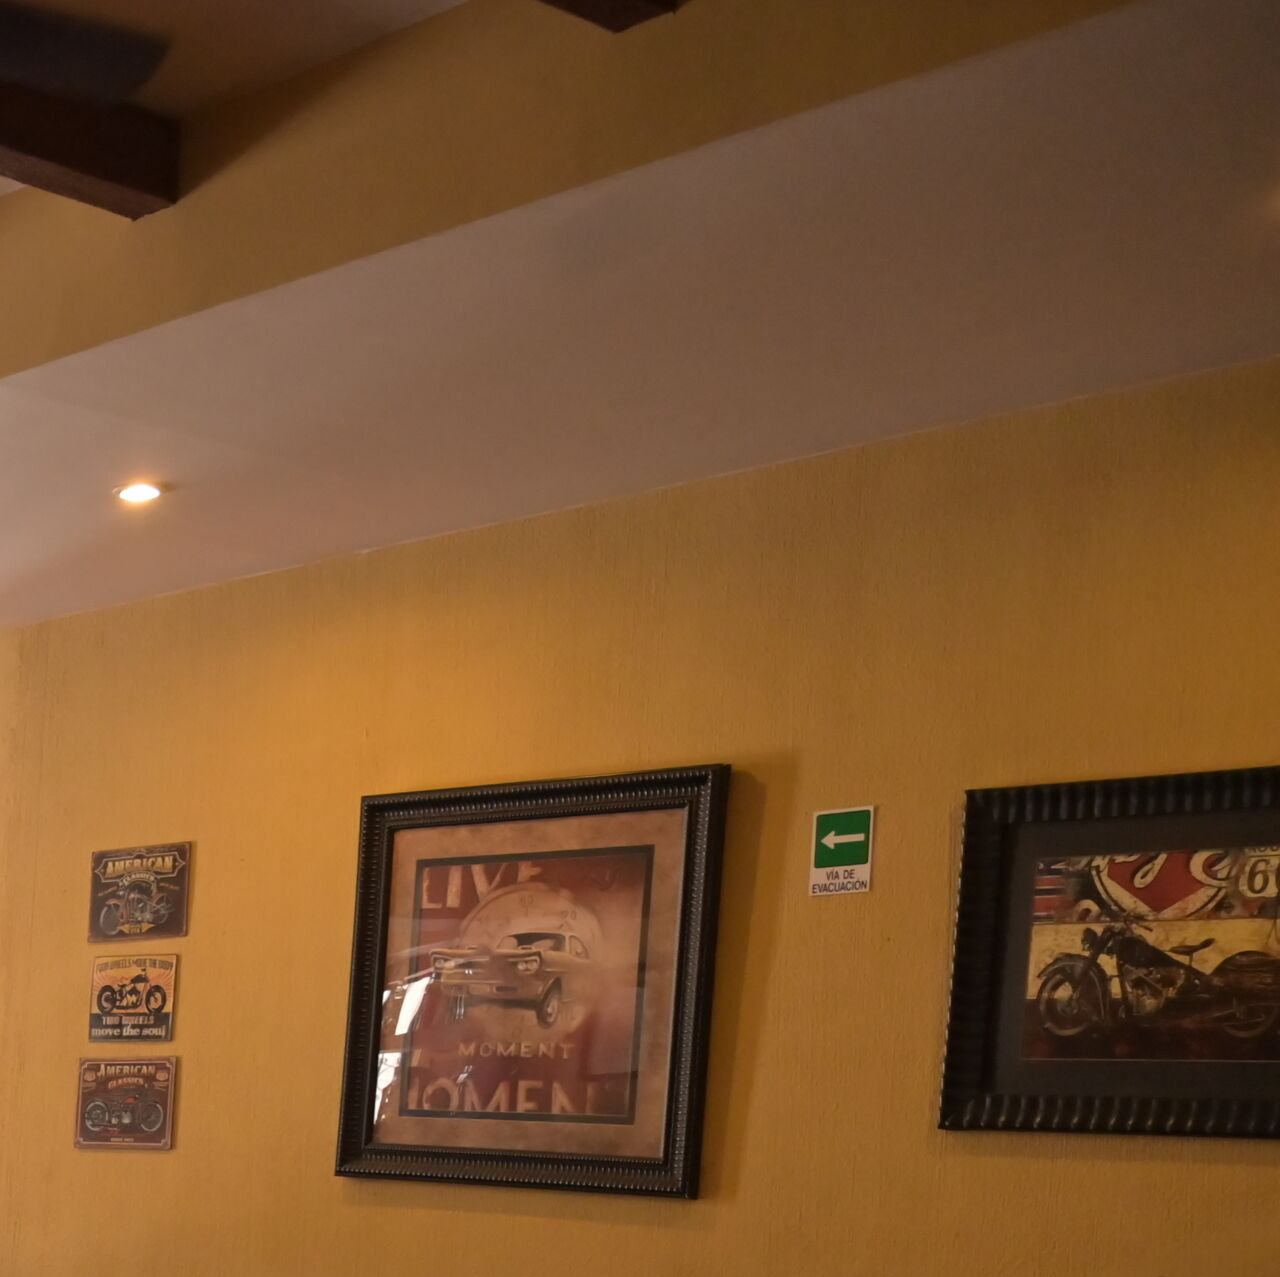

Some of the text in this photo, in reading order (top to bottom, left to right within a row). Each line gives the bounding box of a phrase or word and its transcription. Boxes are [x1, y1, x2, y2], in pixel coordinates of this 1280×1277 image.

[104, 856, 174, 879] AMERICAN
[826, 868, 855, 880] VÍA DE
[812, 878, 868, 893] EVACUACIÓN
[91, 1023, 166, 1039] move the soul
[459, 1041, 575, 1059] MOMENT
[97, 1064, 156, 1077] AMERICAN
